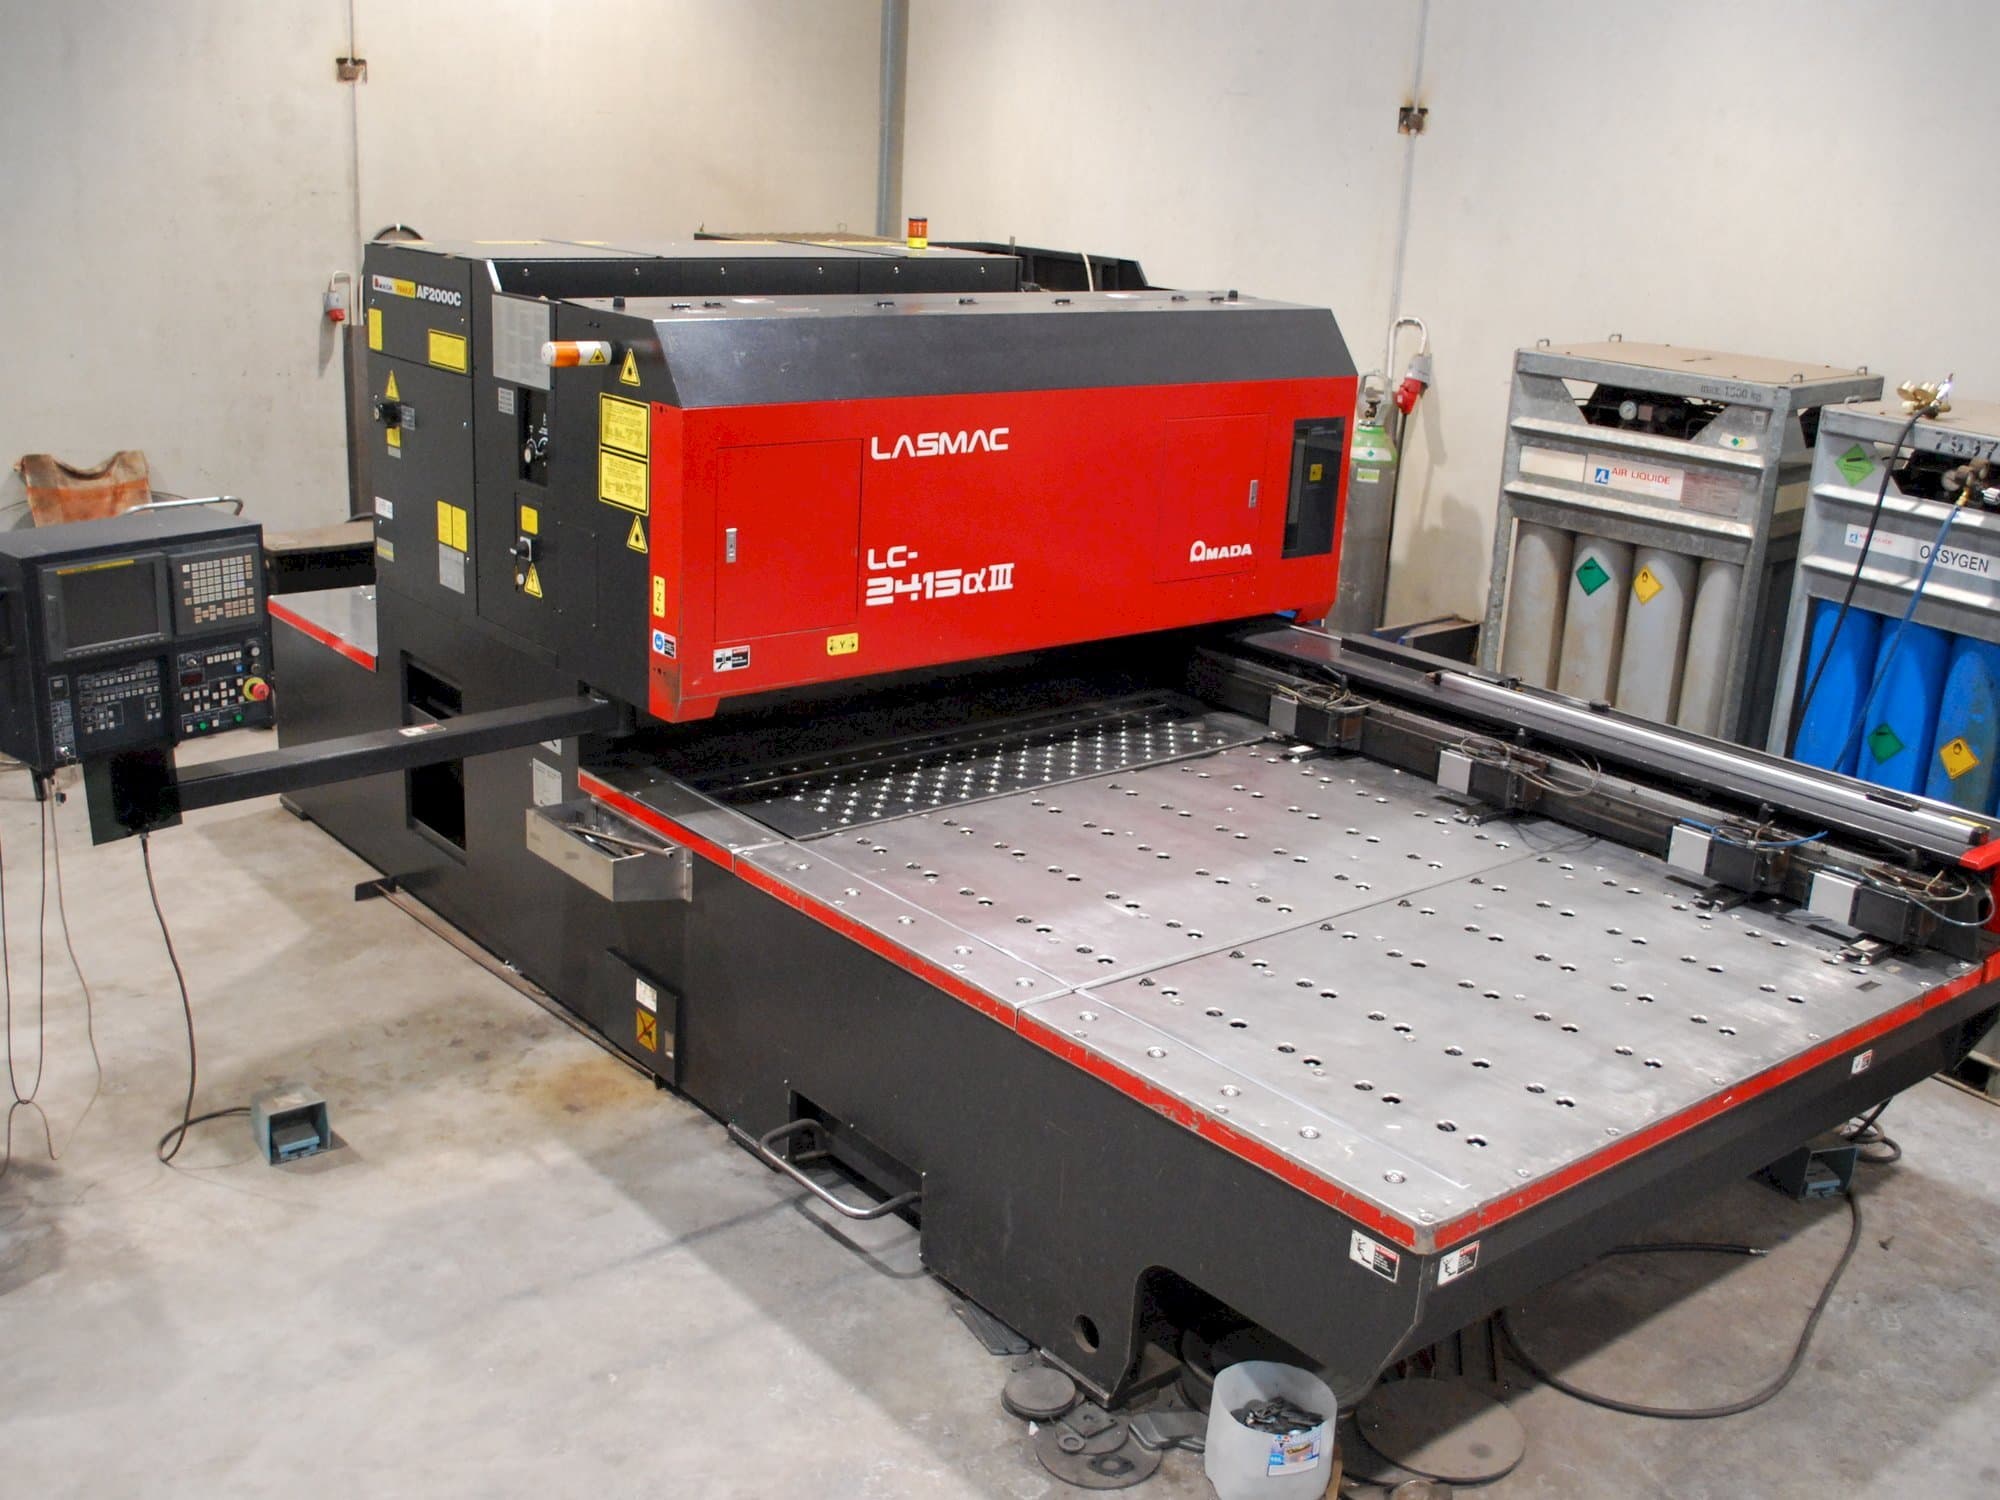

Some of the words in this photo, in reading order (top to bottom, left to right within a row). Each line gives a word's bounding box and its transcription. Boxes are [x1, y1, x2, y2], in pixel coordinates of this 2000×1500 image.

[416, 284, 462, 306] AF2000C
[871, 427, 1009, 460] LASMAC
[1612, 466, 1628, 478] AIR
[867, 545, 918, 570] LC-
[1189, 540, 1253, 562] AMADA
